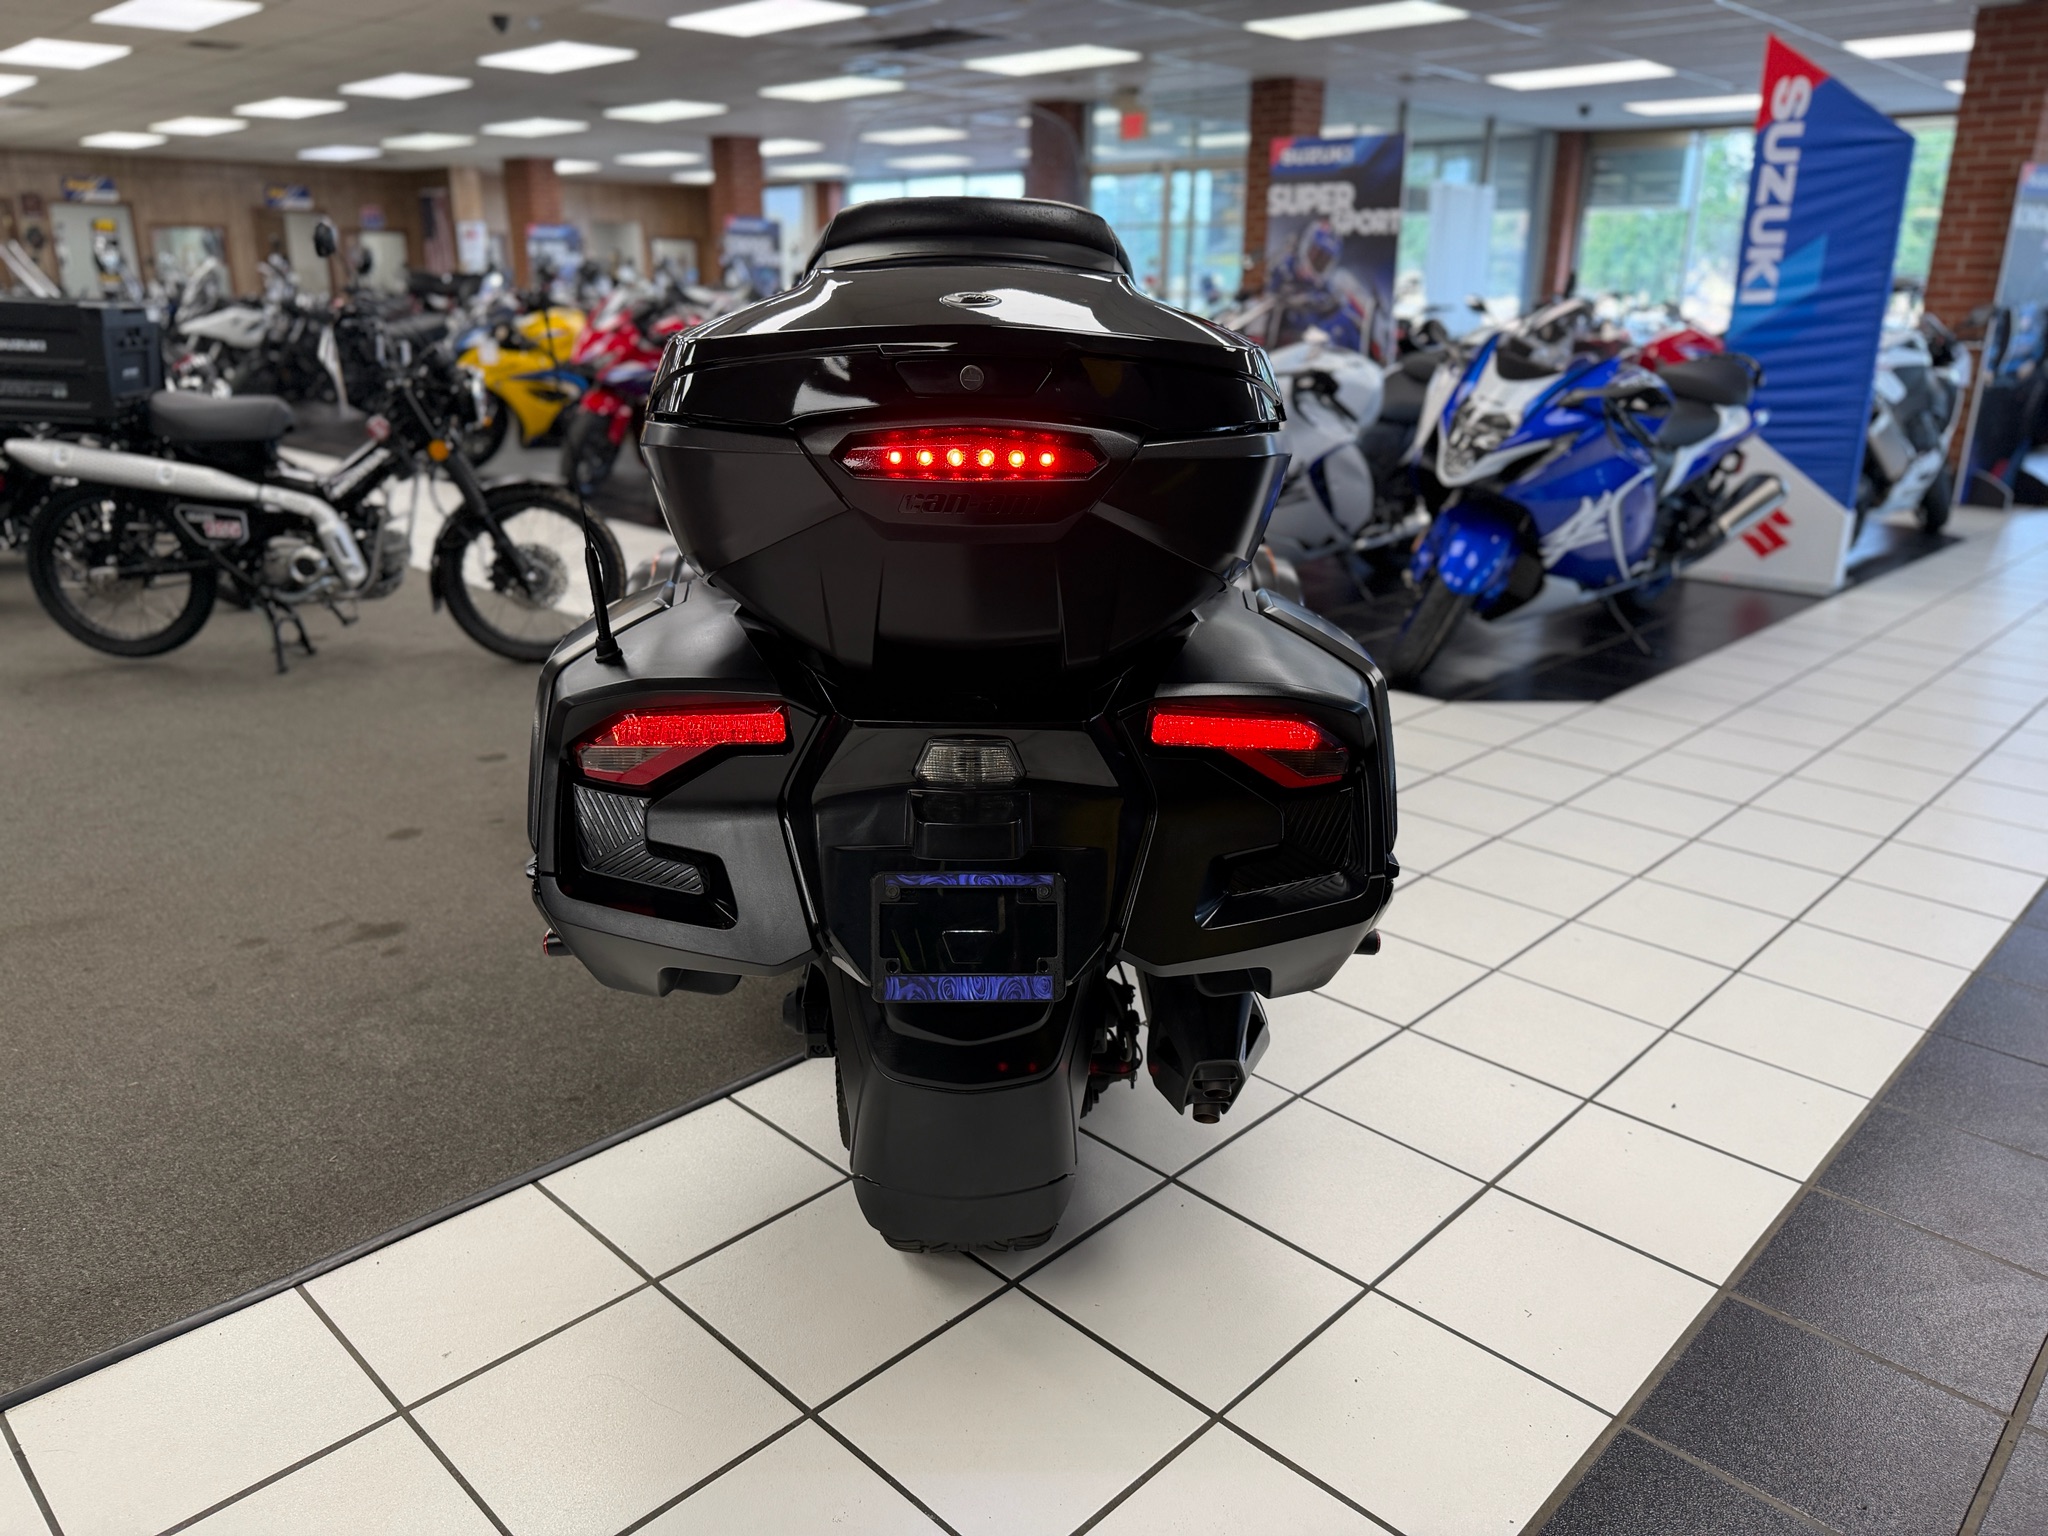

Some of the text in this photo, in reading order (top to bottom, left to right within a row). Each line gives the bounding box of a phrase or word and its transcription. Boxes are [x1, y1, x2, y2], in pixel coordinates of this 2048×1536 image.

[1280, 145, 1355, 167] SUZUKI
[1267, 182, 1355, 217] SUPER
[1741, 74, 1812, 304] SUZUKI
[1331, 206, 1400, 236] SPORT
